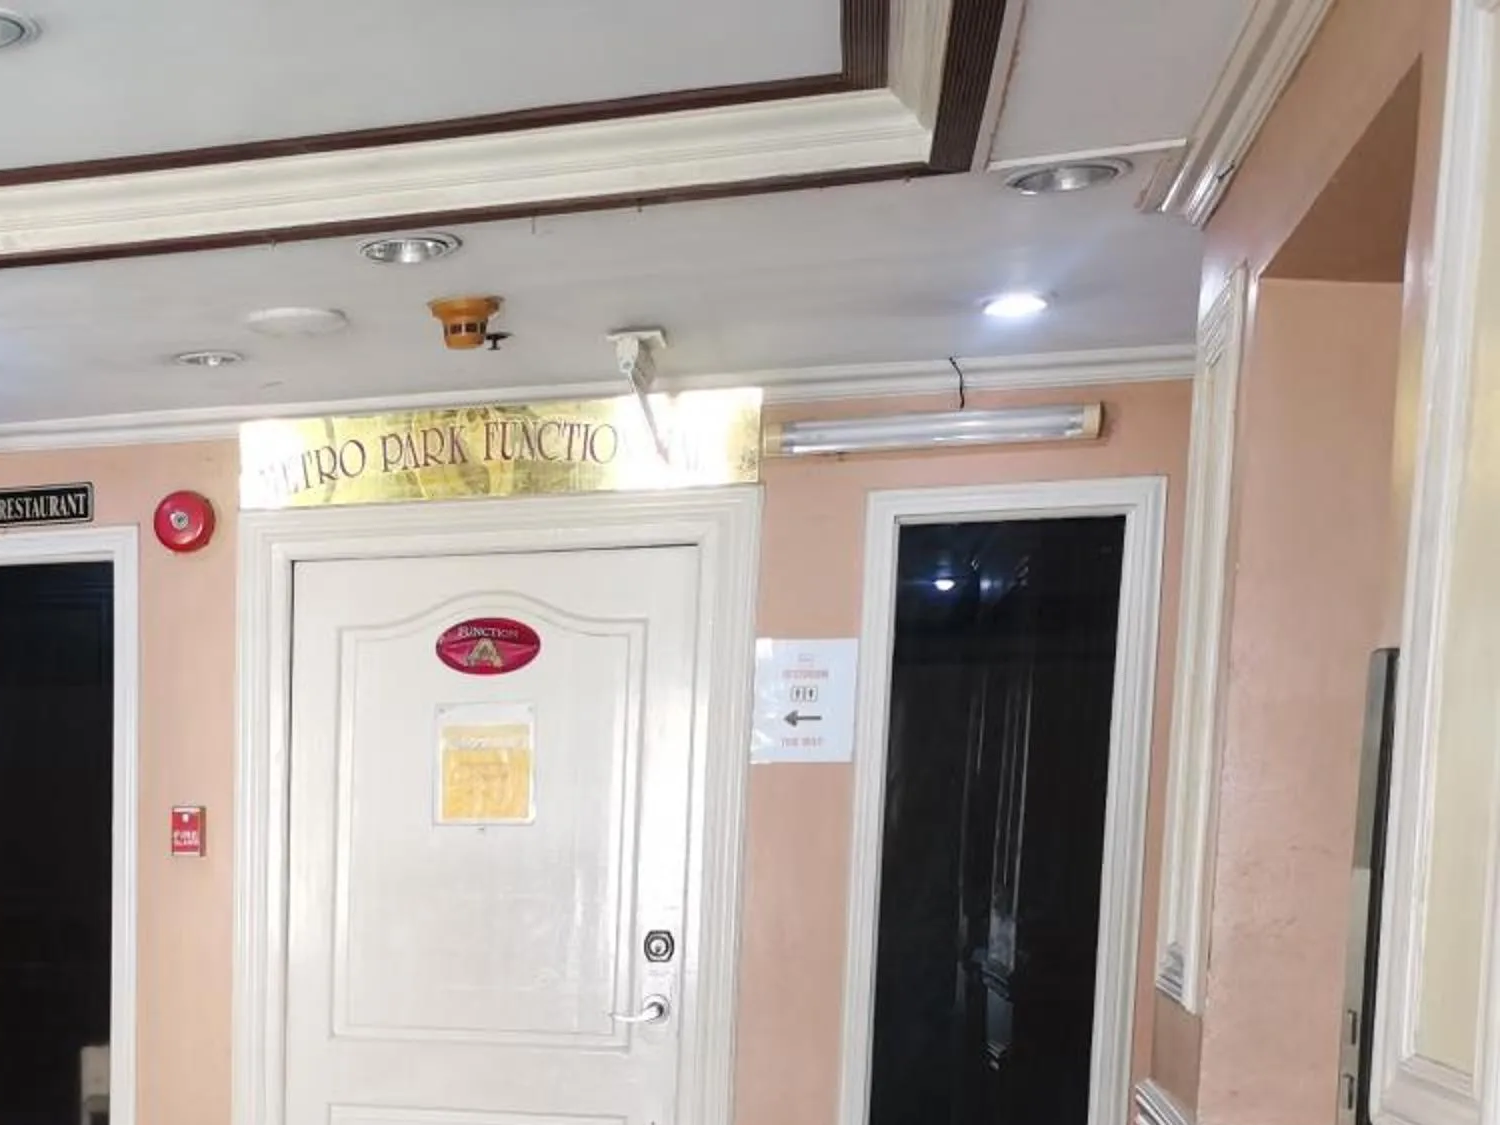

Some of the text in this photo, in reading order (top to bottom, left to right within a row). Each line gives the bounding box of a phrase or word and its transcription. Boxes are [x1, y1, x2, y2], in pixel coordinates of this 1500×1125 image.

[380, 423, 469, 473] PARK
[483, 420, 634, 465] FUNCTIO
[463, 638, 505, 668] A
